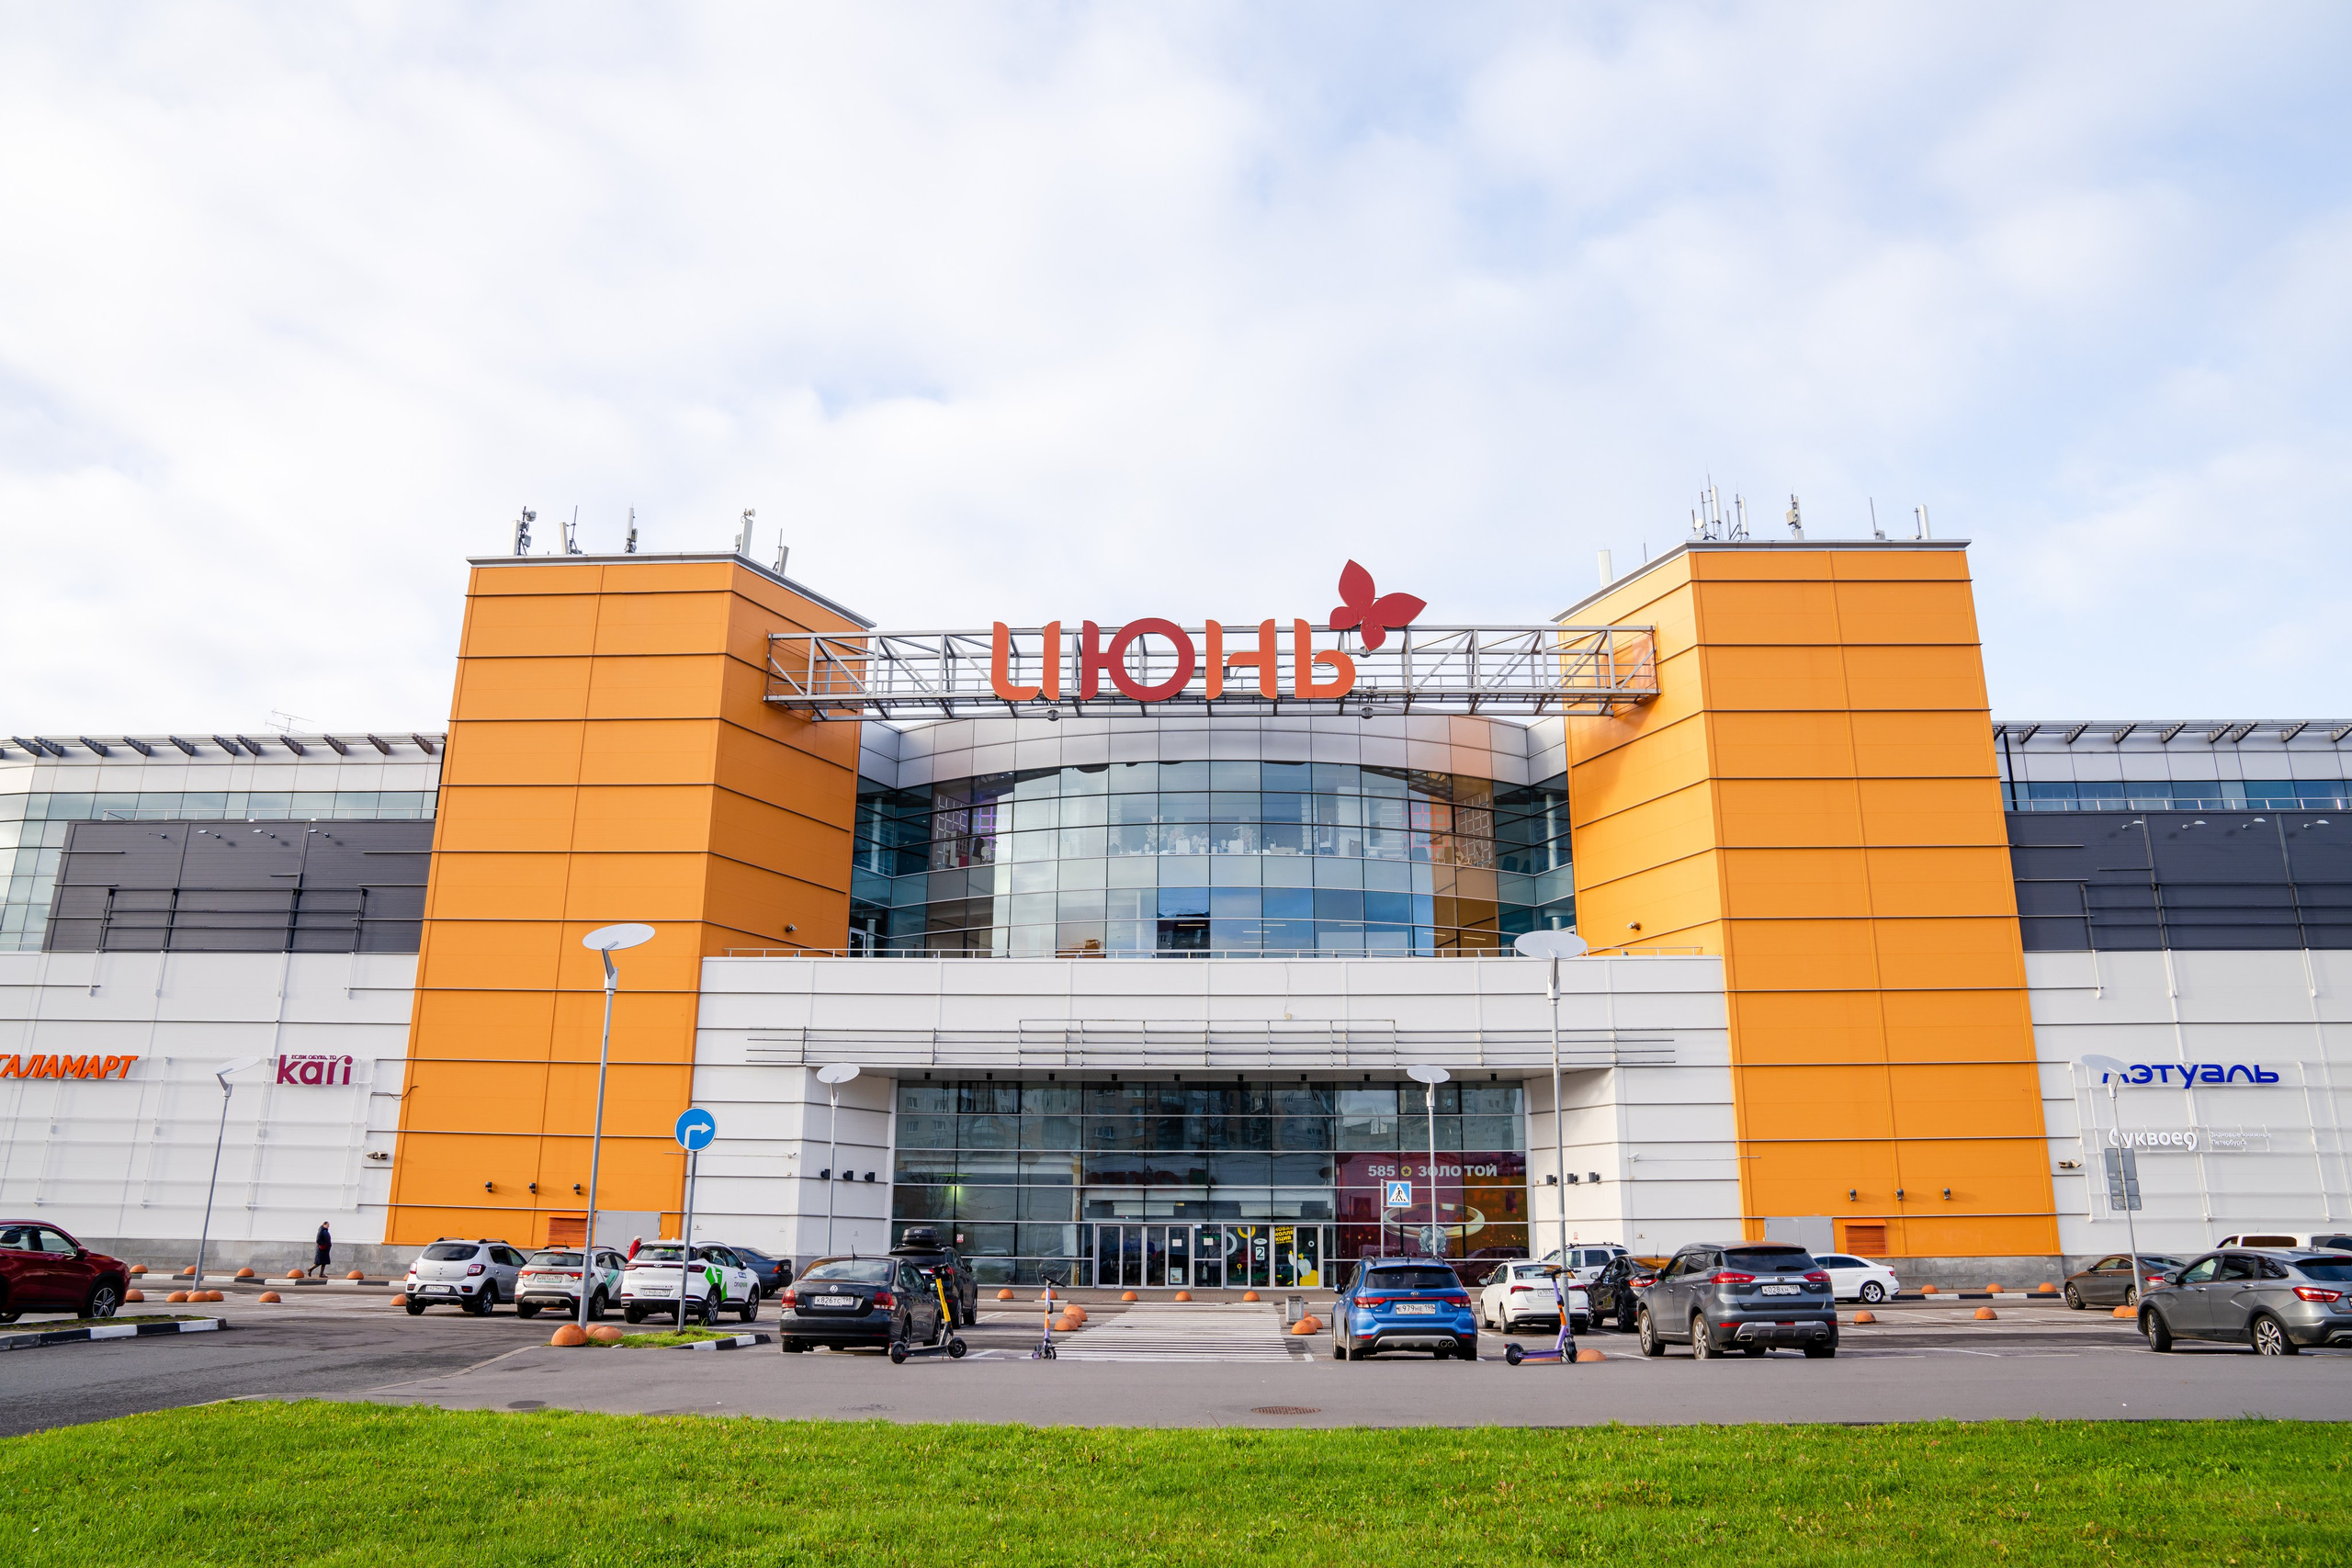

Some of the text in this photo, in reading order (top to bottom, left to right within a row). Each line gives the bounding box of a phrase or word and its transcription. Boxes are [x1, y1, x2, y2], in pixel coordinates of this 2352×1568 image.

[991, 617, 1356, 702] ИЮНЬ
[277, 1055, 353, 1085] kari
[1368, 1165, 1396, 1177] 585
[1256, 1247, 1264, 1258] 2
